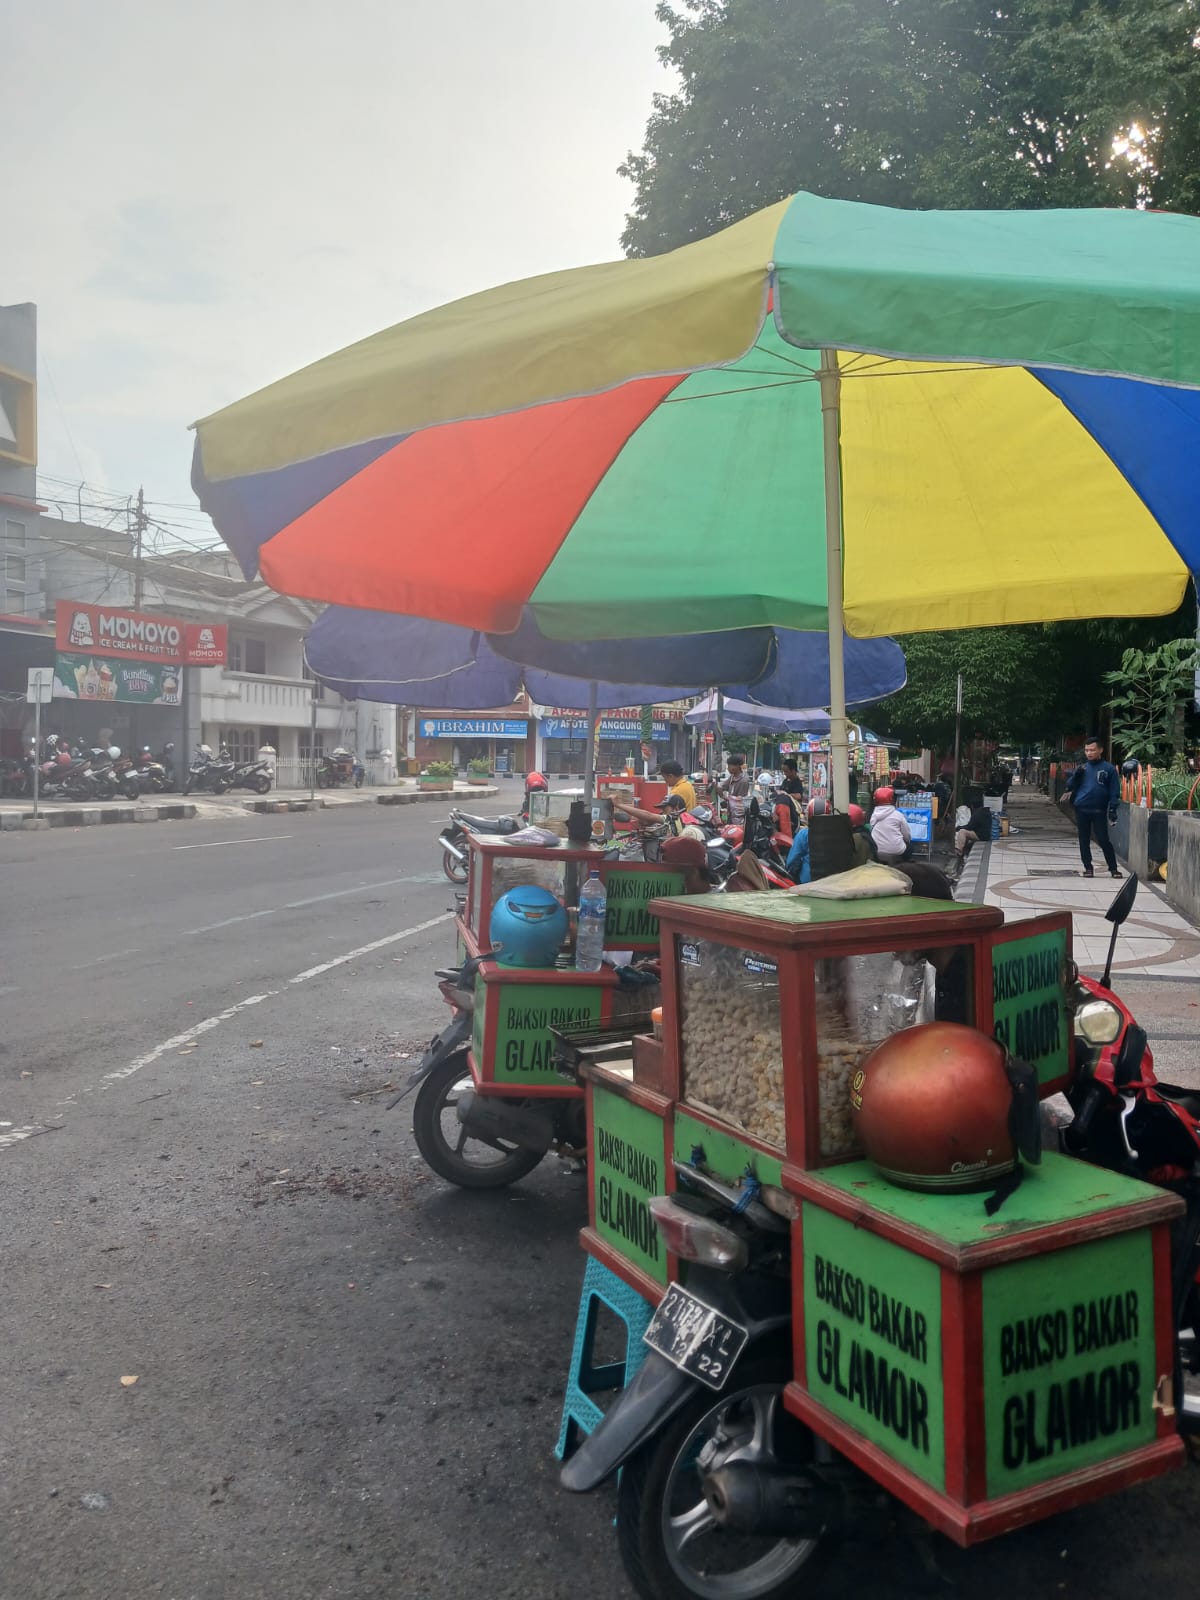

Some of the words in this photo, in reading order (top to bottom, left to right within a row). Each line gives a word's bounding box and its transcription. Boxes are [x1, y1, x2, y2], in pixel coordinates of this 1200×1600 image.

[100, 614, 180, 646] MOMOYO
[101, 639, 111, 648] ICE
[113, 640, 137, 650] CREAM
[145, 644, 164, 654] FRUIT
[166, 647, 180, 656] TEA
[437, 721, 505, 733] IBRAHIM
[652, 722, 666, 732] RMA
[608, 878, 640, 899] BAKSO
[606, 908, 659, 936] GLAMO
[993, 958, 1024, 1003] BAKSO
[1026, 946, 1060, 992] BAKAR
[507, 1008, 547, 1030] BAKSO
[599, 1127, 625, 1174] BAKSO
[627, 1144, 657, 1196] BAKAR
[814, 1254, 865, 1326] BAKSO
[868, 1285, 927, 1365] BAKAR
[1001, 1309, 1068, 1377] BAKSO
[1072, 1289, 1139, 1356] BAKAR
[698, 1353, 722, 1378] 22
[816, 1319, 930, 1456] GLAMOR
[1002, 1361, 1141, 1471] GLAMOR
